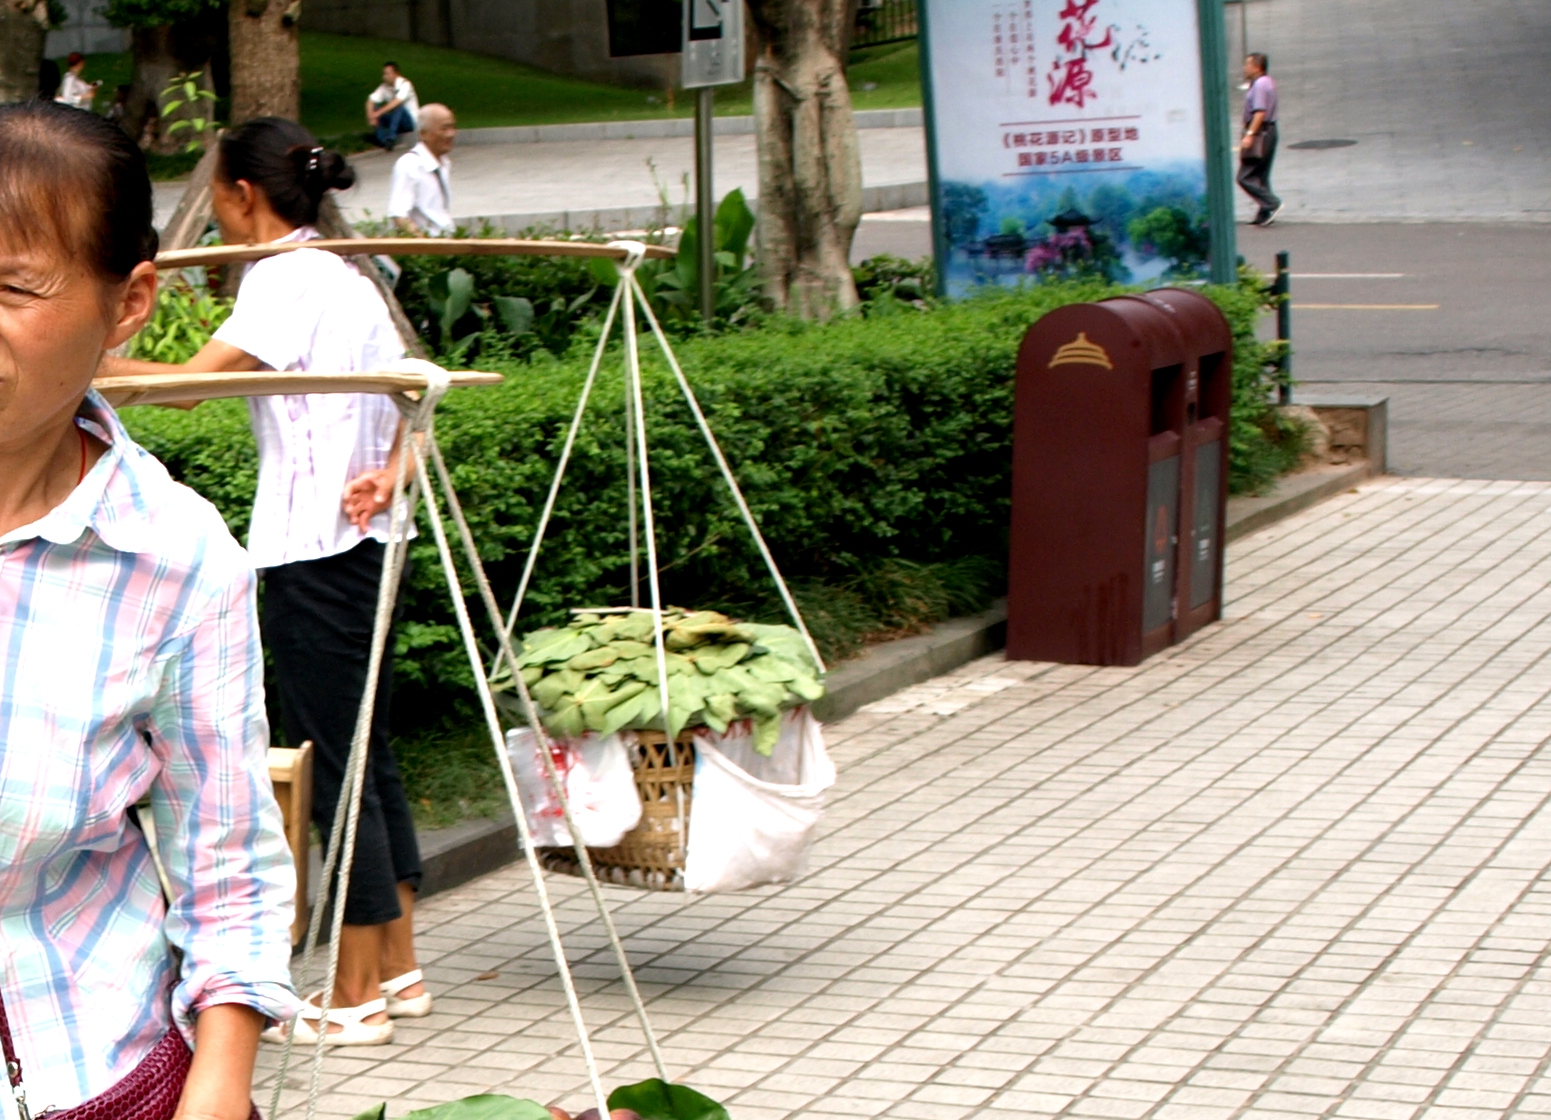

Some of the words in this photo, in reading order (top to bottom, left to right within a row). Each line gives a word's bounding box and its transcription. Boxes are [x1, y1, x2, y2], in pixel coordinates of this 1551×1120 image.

[1017, 147, 1124, 167] 国家5A级景区
